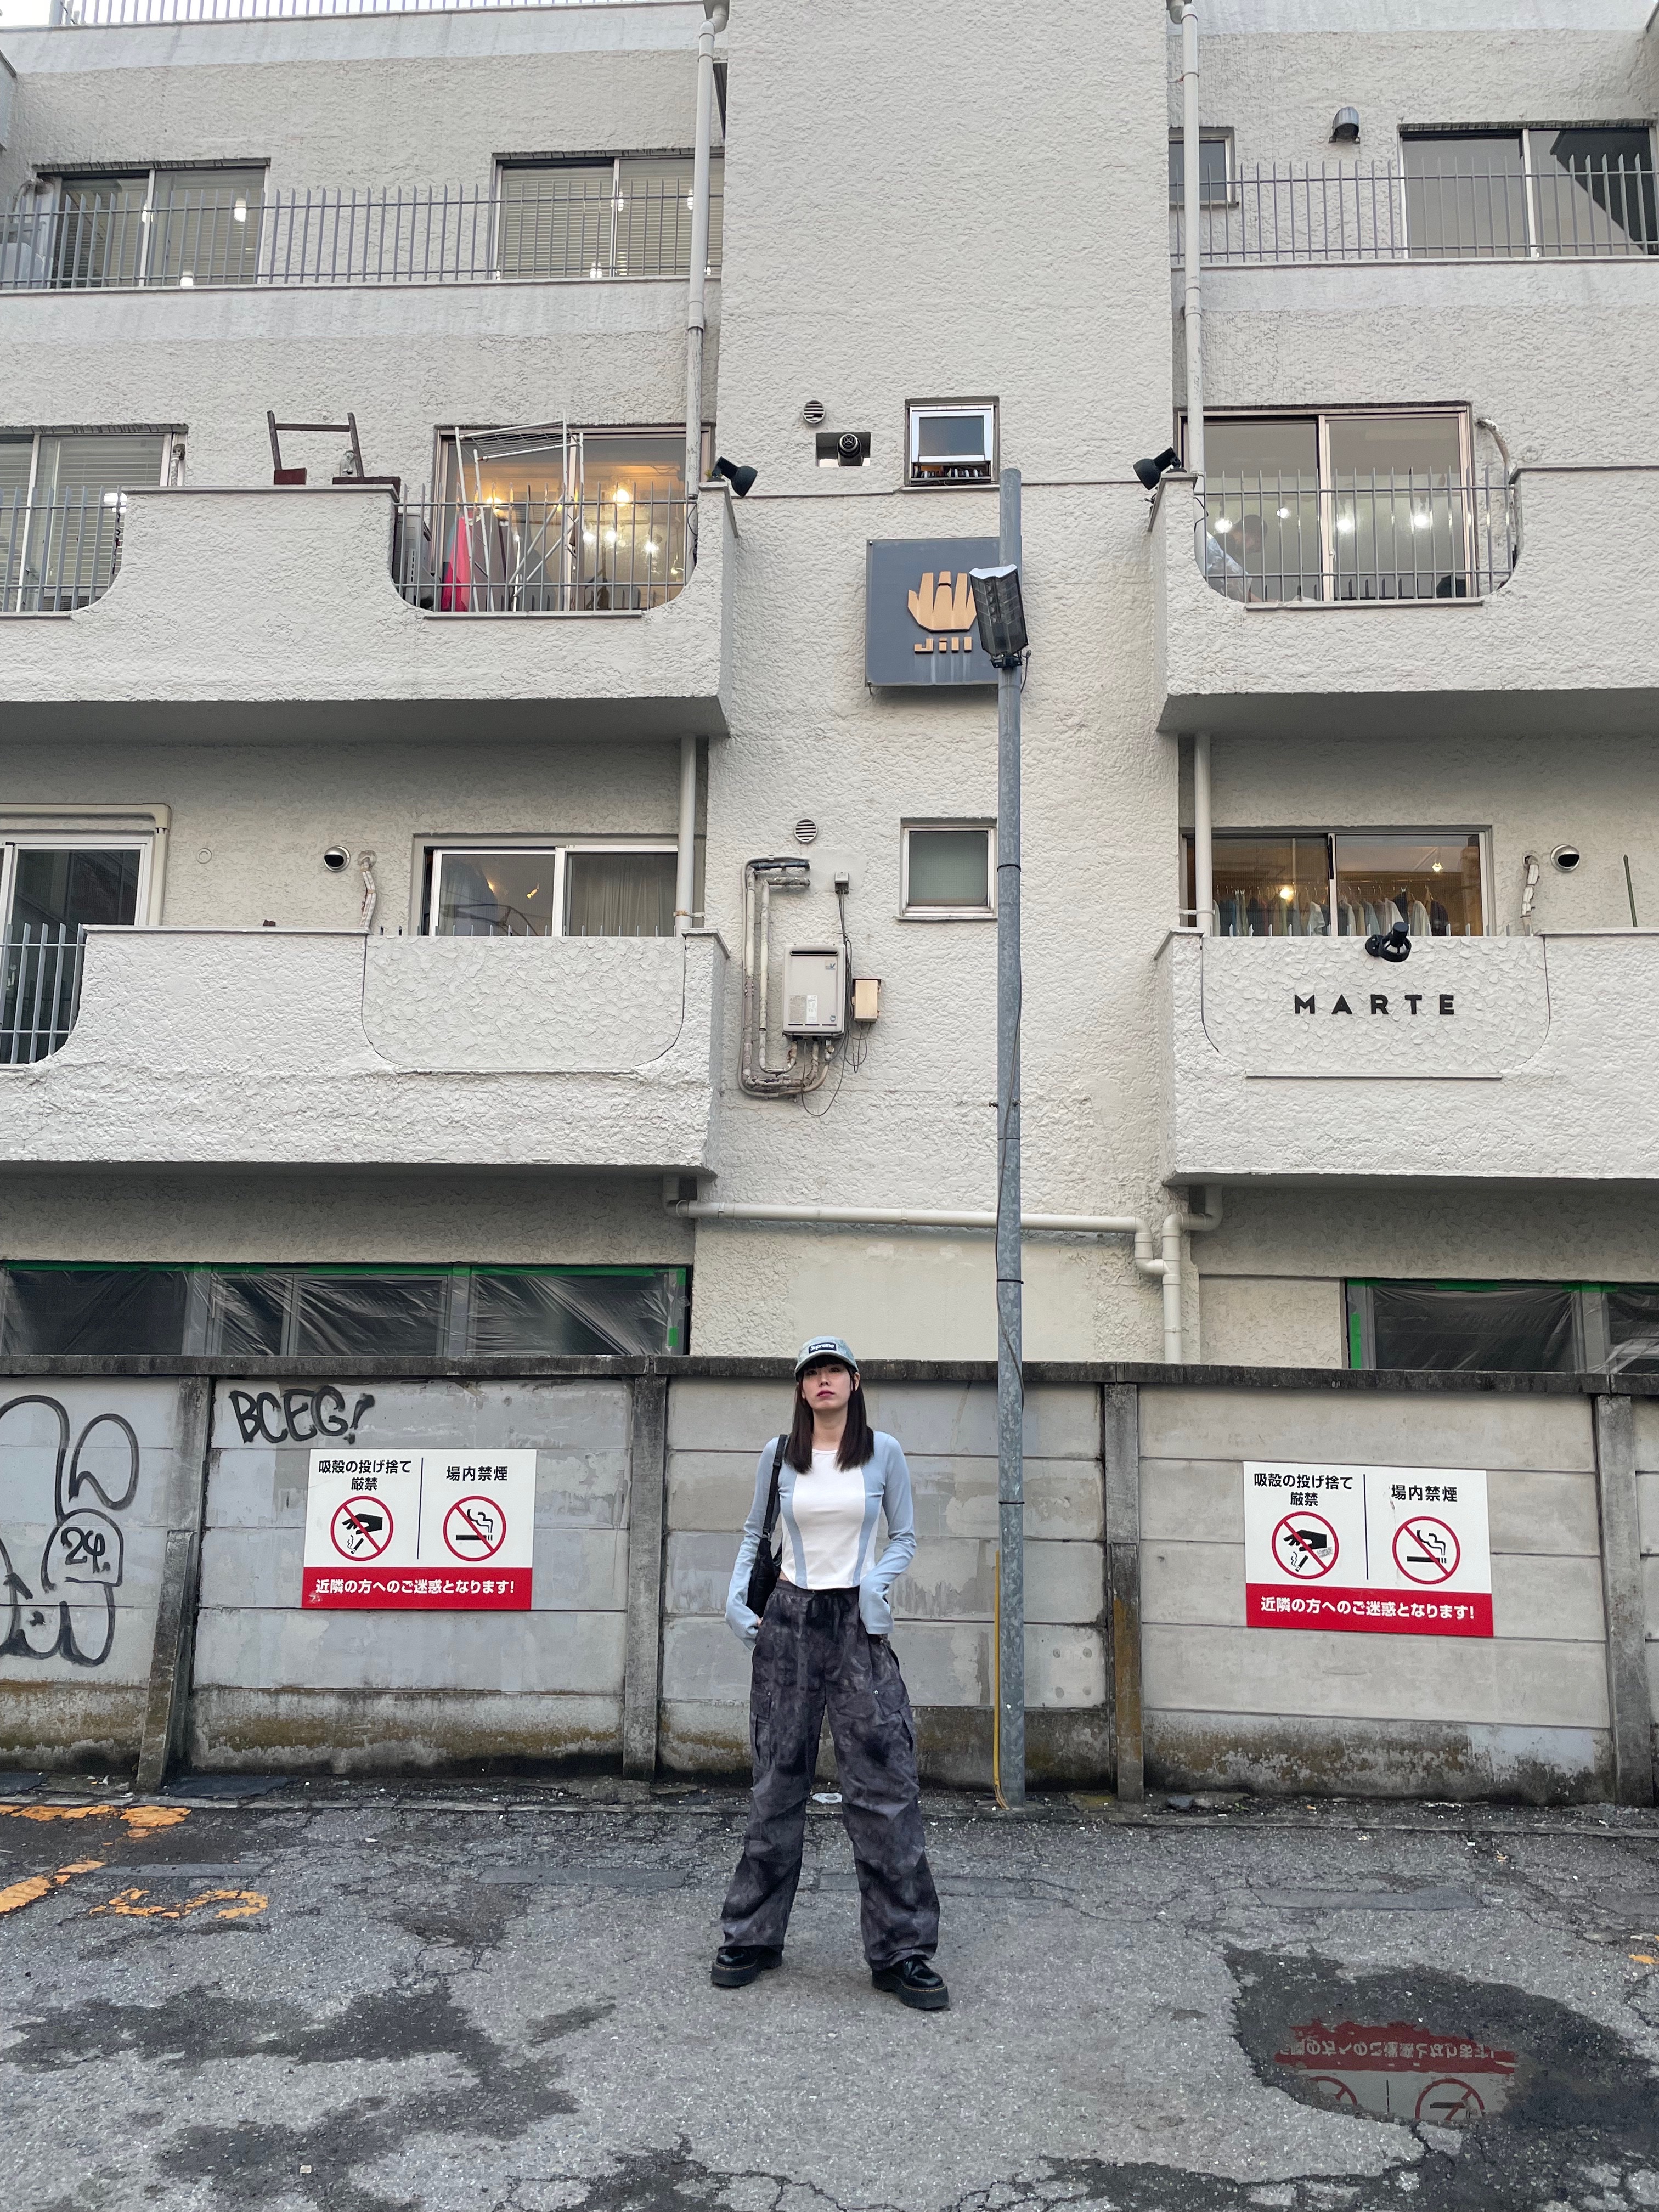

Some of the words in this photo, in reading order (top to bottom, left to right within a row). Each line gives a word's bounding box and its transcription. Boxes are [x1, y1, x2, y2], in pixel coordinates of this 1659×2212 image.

[1294, 994, 1454, 1015] MARTE
[318, 1459, 412, 1475] 吸殻の投げ捨て
[446, 1465, 509, 1481] 場内禁煙
[351, 1476, 378, 1491] 厳禁
[1254, 1472, 1353, 1491] 吸殻の投げ捨て
[1290, 1492, 1319, 1508] 厳禁
[1391, 1485, 1458, 1503] 場内禁煙
[315, 1578, 514, 1595] 近隣の方へのご迷惑となります!
[1261, 1596, 1475, 1620] 近隣の方へのご迷惑となります!
